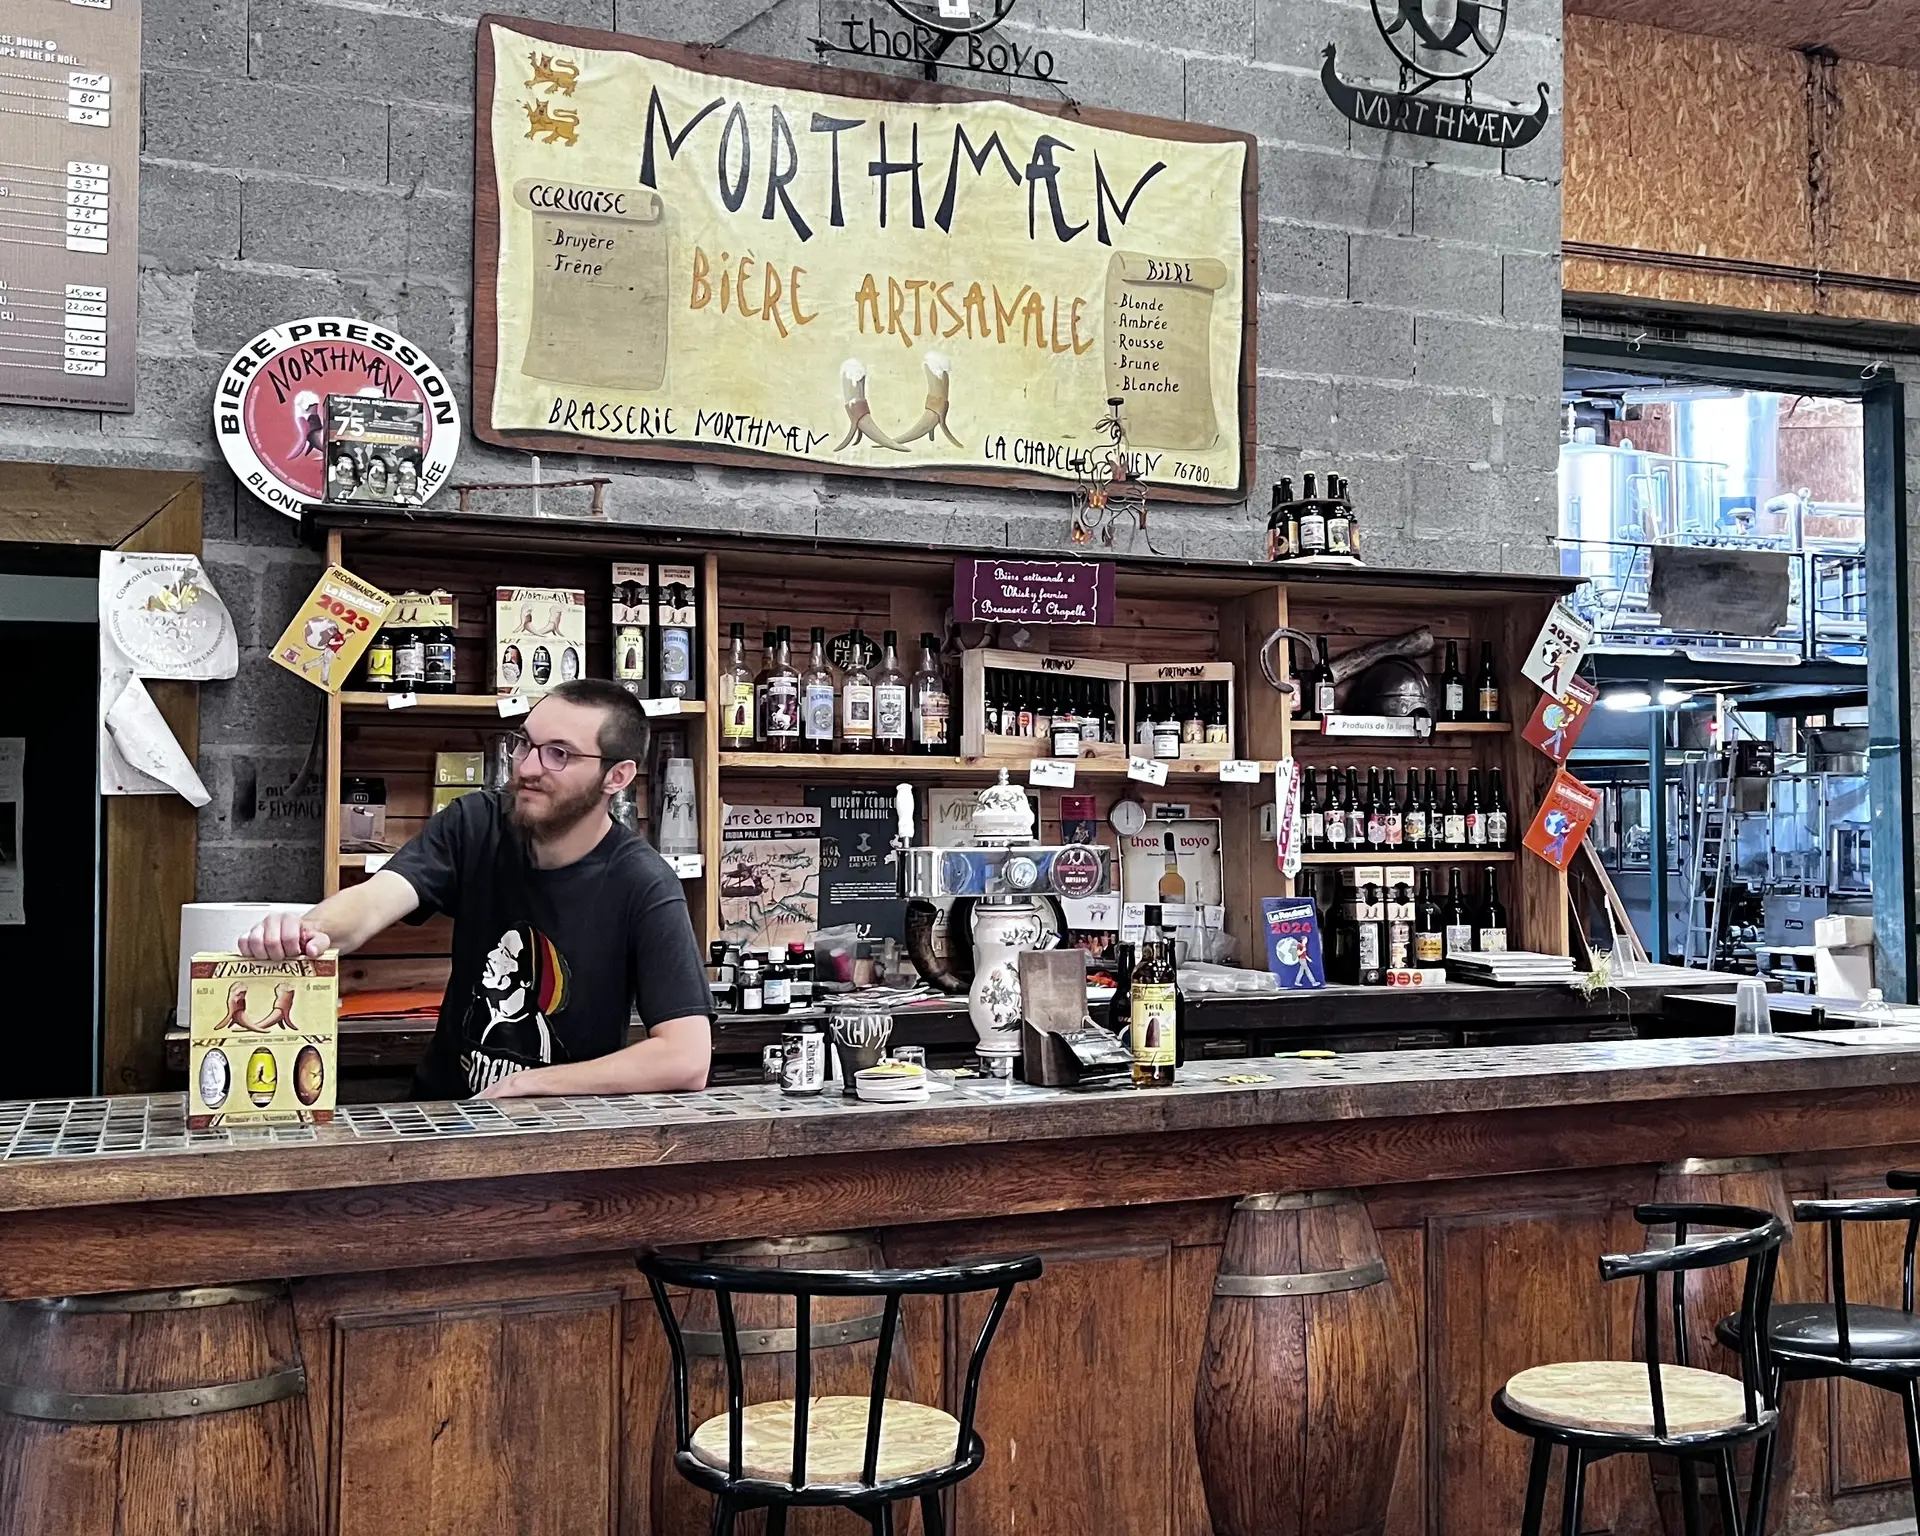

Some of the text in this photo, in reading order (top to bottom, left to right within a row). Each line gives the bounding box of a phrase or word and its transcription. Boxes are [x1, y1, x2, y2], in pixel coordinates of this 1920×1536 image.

[16, 36, 44, 49] BRUNE
[45, 53, 55, 63] DE
[854, 272, 1095, 356] ARTISANALE
[220, 337, 277, 435] BIERE
[288, 322, 455, 426] PRESSION
[334, 415, 366, 437] 75
[985, 434, 1007, 461] LA
[1174, 461, 1211, 483] 76780
[315, 593, 371, 632] 2023
[1548, 623, 1581, 654] 2022
[1270, 922, 1313, 935] 2024
